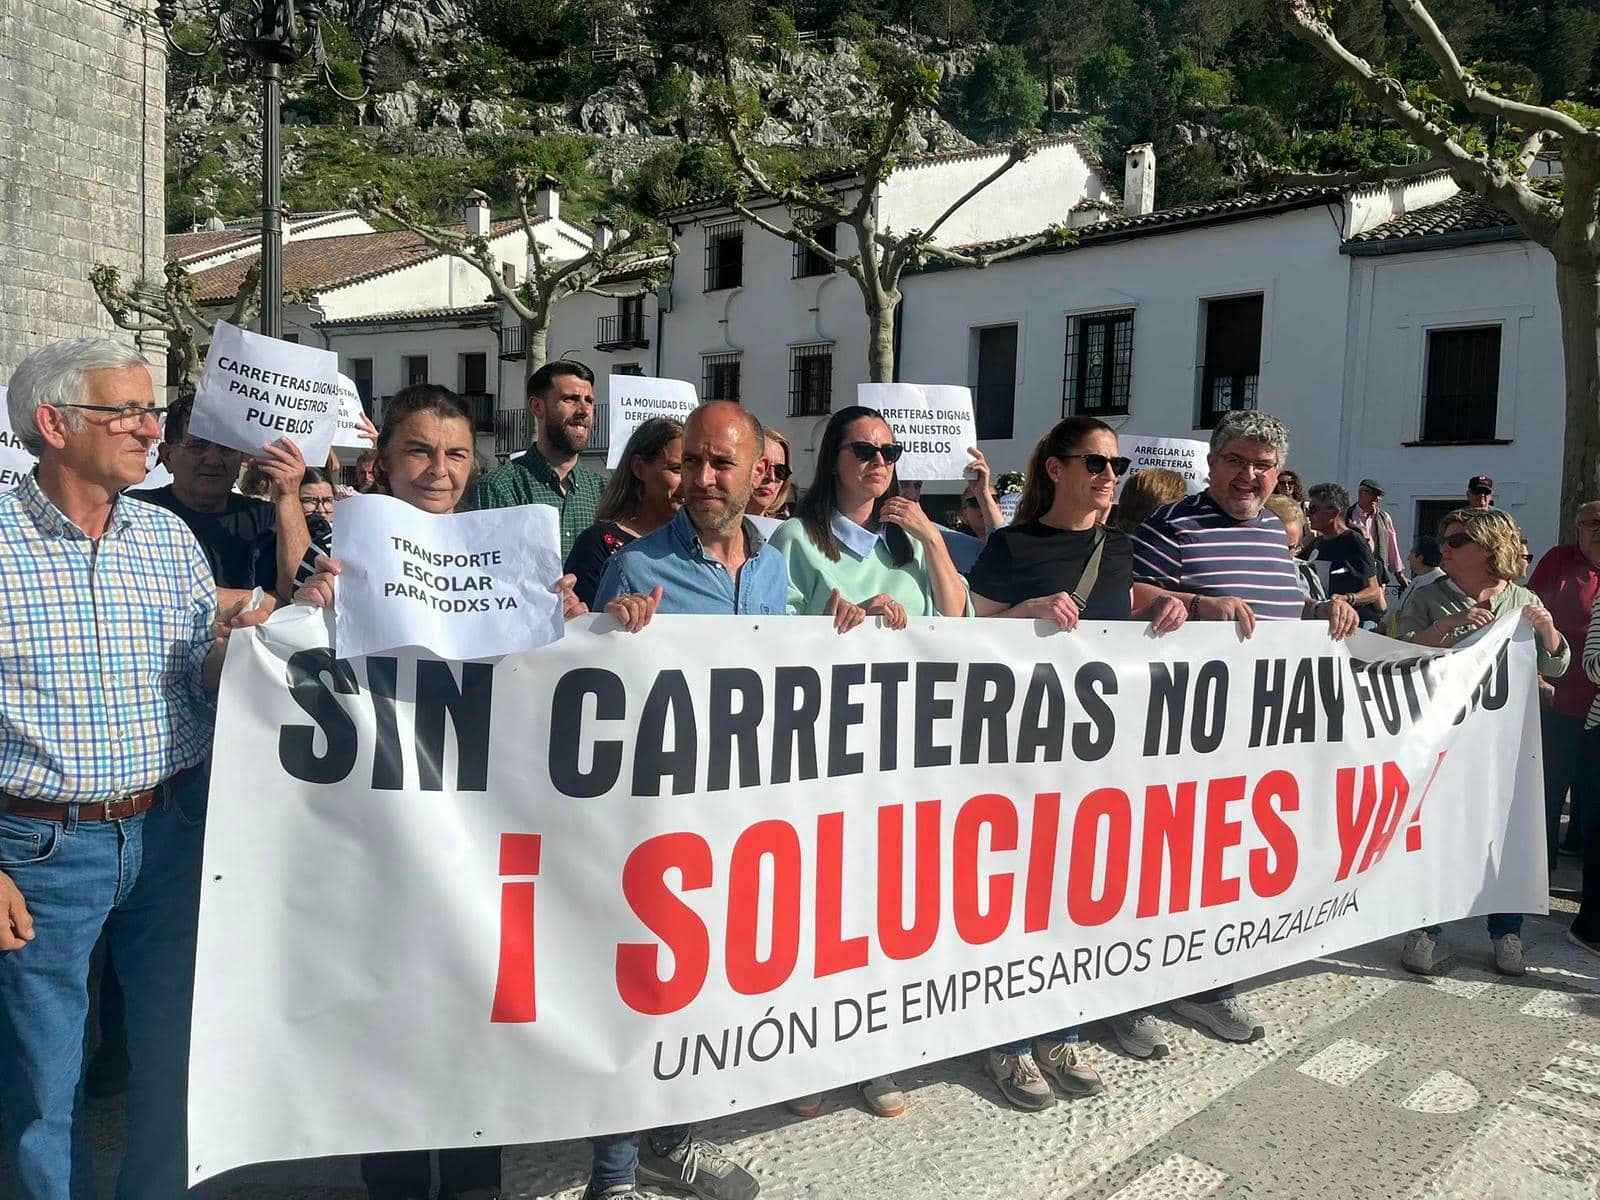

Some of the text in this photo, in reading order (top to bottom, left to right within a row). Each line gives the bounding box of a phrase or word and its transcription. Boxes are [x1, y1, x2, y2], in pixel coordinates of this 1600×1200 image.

[218, 356, 311, 393] CARRETERAS
[229, 380, 270, 404] PARA
[274, 393, 329, 413] NUESTROS
[620, 397, 632, 406] LA
[634, 398, 677, 410] MOVILIDAD
[679, 401, 687, 410] ES
[246, 407, 314, 434] PUEBLOS
[877, 408, 970, 421] ARRETERAS DIGNAS
[909, 425, 961, 435] NUESTROS
[1134, 446, 1195, 457] ARREGLAR LAS
[1138, 457, 1193, 469] CARRETERAS
[390, 536, 502, 567] TRANSPORTE
[402, 560, 493, 592] ESCOLAR
[384, 582, 518, 613] PARA TODXS YA
[279, 647, 494, 792] SIN
[548, 661, 1118, 798] CARRETERAS
[1142, 660, 1230, 758] NO
[1248, 655, 1345, 749] HAY
[615, 769, 1300, 1017] SOLUCIONES
[652, 887, 1360, 1082] UNIÓN DE EMPRESARIOS DE GRAZALEMA
